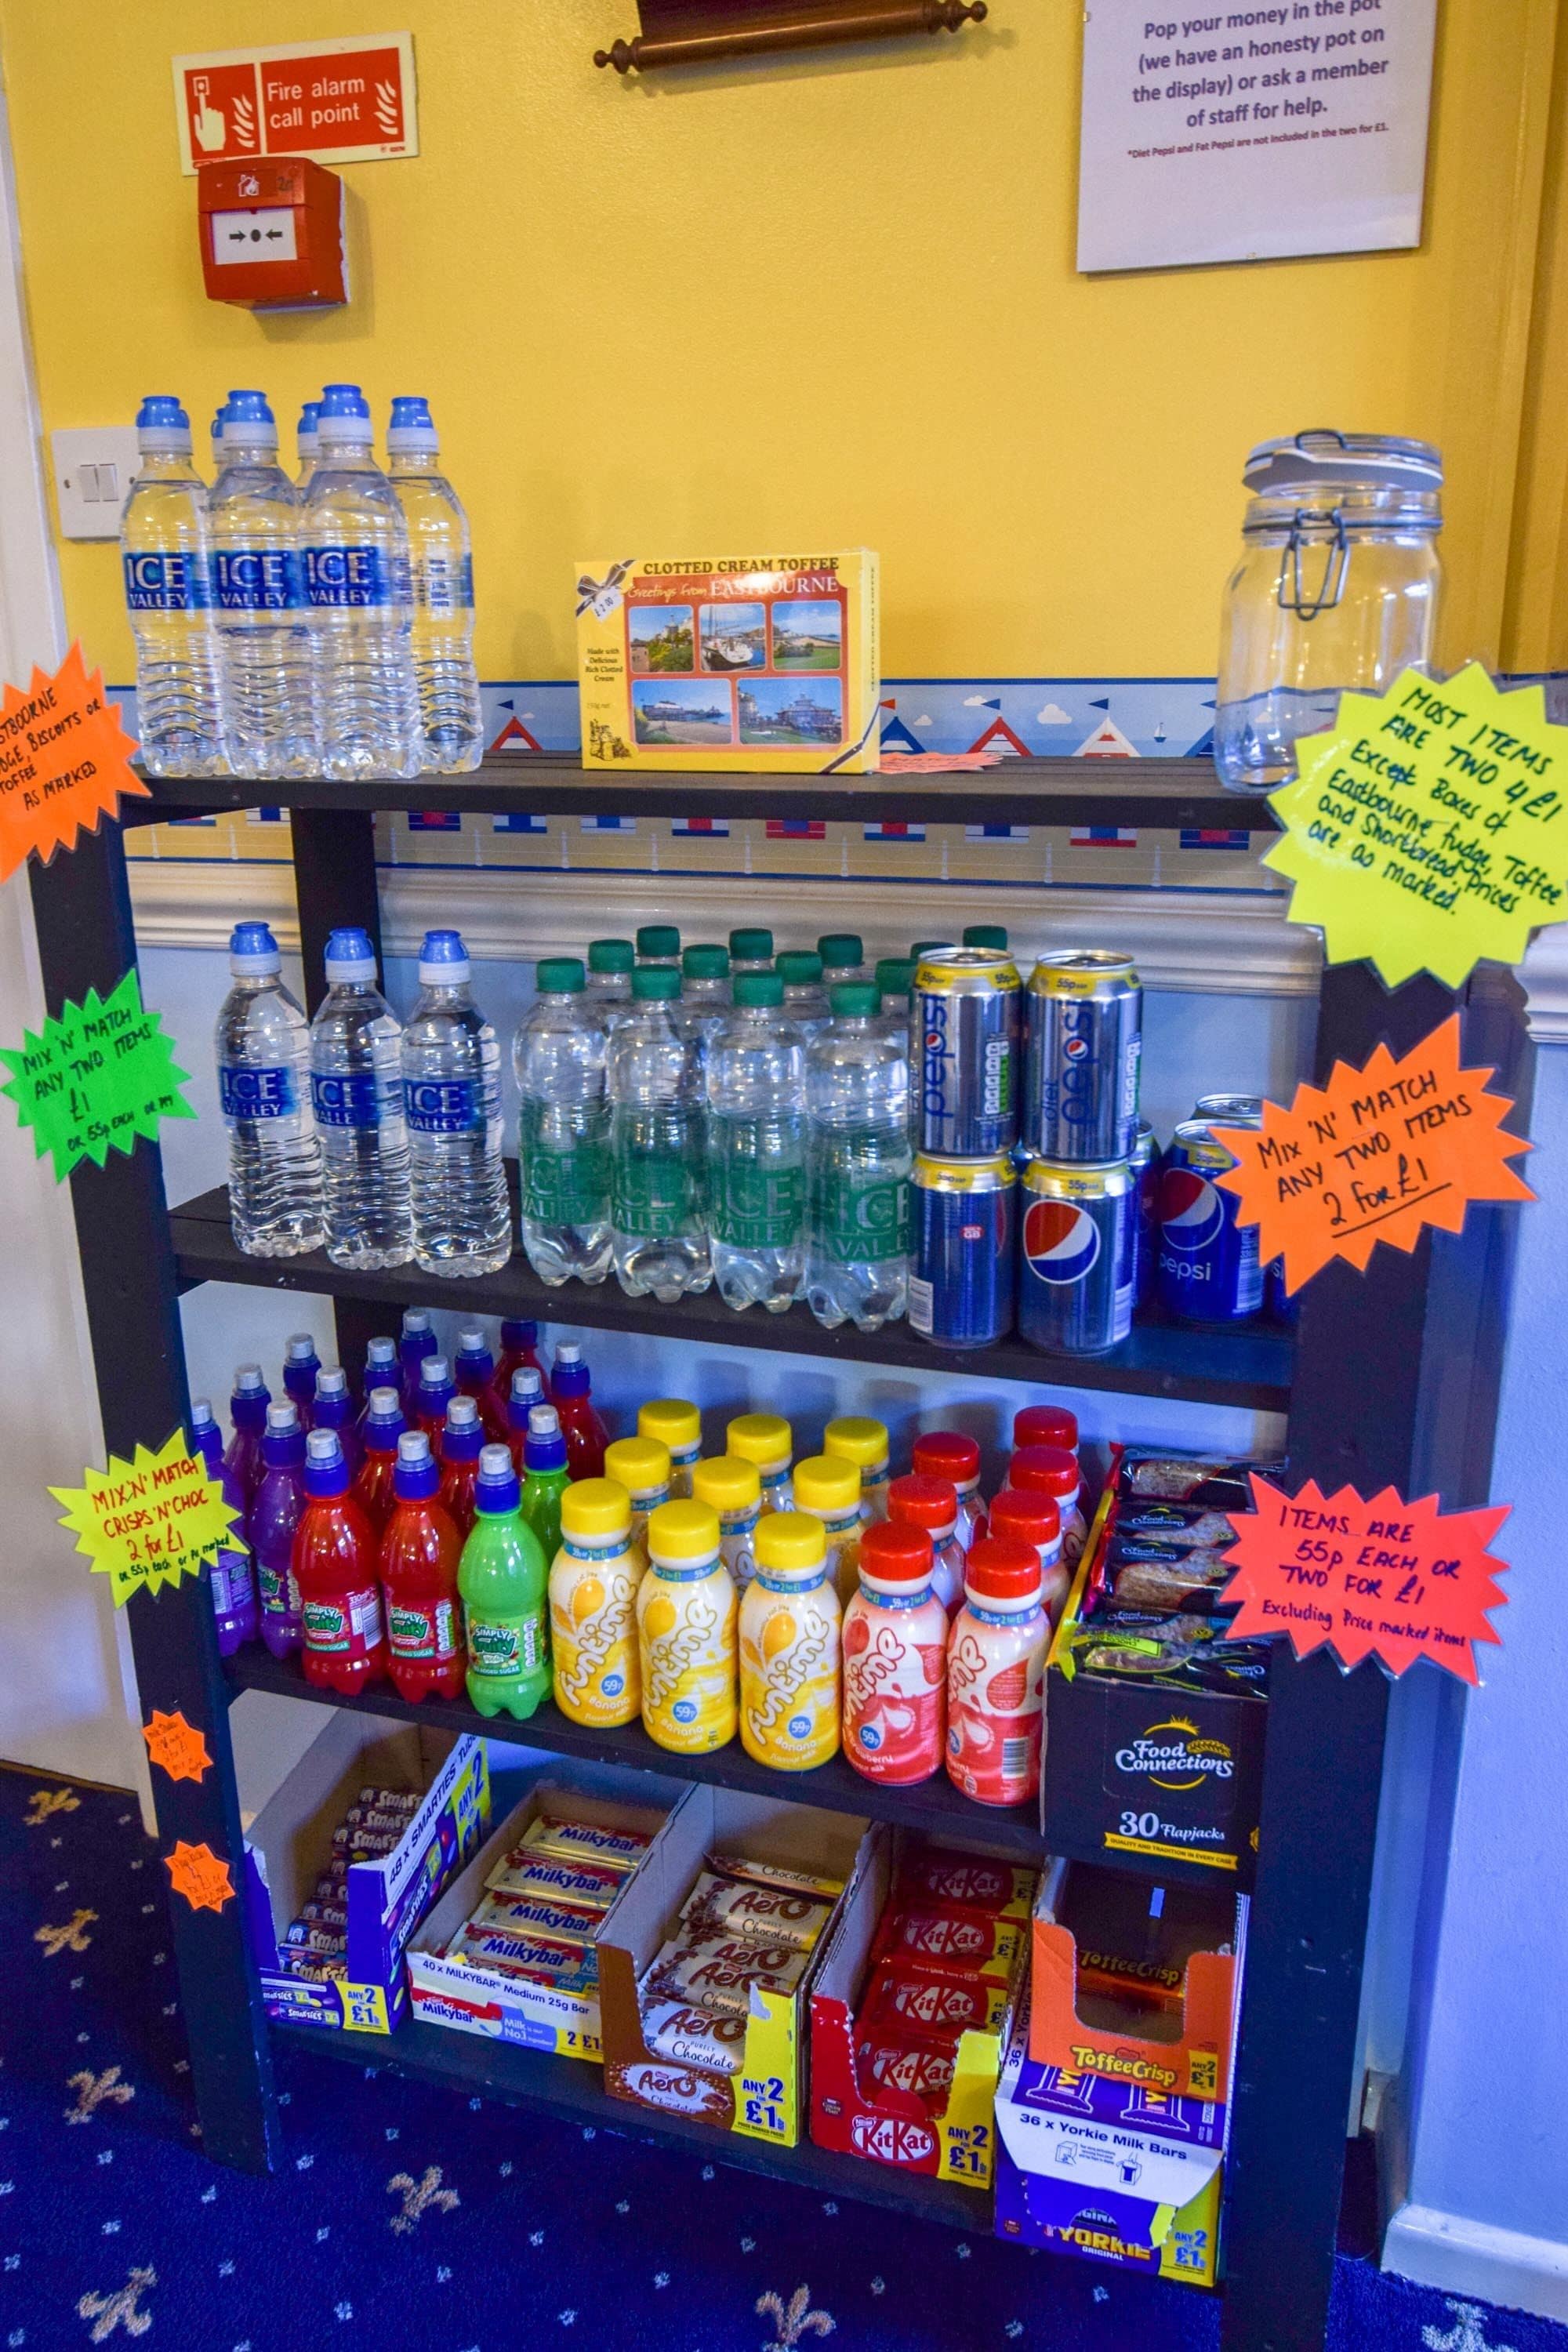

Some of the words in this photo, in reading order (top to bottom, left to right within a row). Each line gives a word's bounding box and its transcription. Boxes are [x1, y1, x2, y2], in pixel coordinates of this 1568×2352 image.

[1145, 23, 1177, 39] Pop
[1182, 16, 1221, 38] your
[1227, 9, 1288, 27] money
[1293, 3, 1308, 20] in
[1315, 0, 1345, 16] the
[1350, 0, 1381, 16] pot
[1139, 53, 1171, 74] (we
[1176, 49, 1217, 66] have
[1222, 45, 1243, 60] an
[1249, 36, 1320, 57] honesty
[1326, 30, 1356, 52] pot
[1361, 28, 1384, 43] on
[267, 82, 303, 101] Fire
[311, 78, 365, 97] alarm
[1132, 85, 1160, 103] the
[1166, 74, 1232, 100] display)
[1238, 76, 1257, 89] or
[1261, 68, 1290, 87] ask
[1296, 70, 1305, 83] a
[1312, 59, 1389, 81] member
[270, 109, 303, 129] call
[311, 103, 361, 129] point
[1186, 109, 1205, 127] of
[1209, 103, 1249, 125] staff
[1253, 103, 1279, 119] for
[1284, 96, 1327, 117] help.
[1152, 146, 1175, 157] Pepsi
[1177, 143, 1193, 154] and
[1196, 143, 1209, 151] Fat
[1211, 140, 1234, 150] Pepsi
[1236, 138, 1250, 147] are
[1253, 136, 1269, 145] not
[1271, 131, 1308, 143] included
[1311, 130, 1319, 139] in
[1322, 129, 1337, 137] the
[1339, 127, 1357, 136] two
[1359, 124, 1373, 133] for
[128, 558, 186, 590] ICE
[307, 552, 369, 585] ICE
[644, 562, 712, 575] CLOTTED
[717, 560, 772, 572] CREAM
[779, 557, 839, 570] TOFFEE
[129, 593, 189, 608] VALLEY
[309, 590, 372, 604] VALLEY
[628, 584, 677, 601] Greetings
[681, 583, 706, 596] from
[1400, 688, 1468, 729] MOST
[1469, 724, 1554, 776] ITEMS
[1381, 714, 1432, 750] ARE
[1445, 745, 1499, 785] TWO
[23, 789, 40, 811] AS
[43, 760, 96, 799] MARKED
[1350, 739, 1418, 790] Except
[1429, 779, 1484, 821] Boxes
[1484, 811, 1512, 837] of
[1319, 795, 1356, 826] and
[1308, 820, 1341, 850] are
[1352, 845, 1375, 868] as
[1328, 769, 1434, 839] Eastbourne
[1504, 855, 1563, 906] Toffee
[23, 1048, 53, 1076] MIX
[83, 1008, 132, 1043] MATCH
[919, 993, 956, 1118] pepsi
[34, 1072, 64, 1101] ANY
[69, 1051, 105, 1081] TWO
[113, 1023, 151, 1059] ITEMS
[1057, 1000, 1099, 1125] pepsi
[405, 1085, 461, 1114] ICE
[1352, 1070, 1438, 1125] MATCH
[408, 1116, 463, 1131] VALLEY
[1278, 1162, 1323, 1203] ANY
[1334, 1131, 1391, 1170] TWO
[1405, 1094, 1472, 1140] ITEMS
[1323, 1192, 1347, 1225] 2
[1399, 1153, 1428, 1196] £1
[1160, 1253, 1211, 1281] pepsi
[91, 1484, 127, 1514] MIX
[151, 1458, 198, 1490] MATCH
[103, 1509, 154, 1539] CRISPS
[172, 1488, 209, 1514] CHOC
[1279, 1505, 1350, 1535] ITEMS
[1367, 1520, 1415, 1543] ARE
[126, 1539, 143, 1561] 2
[144, 1534, 162, 1560] for
[1294, 1540, 1343, 1571] 55p
[1357, 1546, 1418, 1571] EACH
[1431, 1559, 1461, 1580] OR
[1279, 1564, 1329, 1588] TWO
[1344, 1573, 1382, 1599] FOR
[1394, 1574, 1425, 1606] £1
[1262, 1599, 1333, 1632] Excluding
[1342, 1609, 1374, 1631] Price
[1378, 1620, 1429, 1640] marked
[603, 1679, 622, 1692] 59p
[1115, 1748, 1235, 1778] Connections
[1133, 1740, 1186, 1760] Food
[411, 1766, 458, 1849] SMARTIES
[559, 1828, 640, 1852] Milkybar
[1119, 1811, 1160, 1838] 30
[1160, 1824, 1225, 1842] Flapjacks
[742, 1918, 801, 1944] Chocolate
[483, 1937, 575, 1967] Milkybar
[423, 1960, 435, 1970] 40
[503, 1984, 546, 2003] Medium
[549, 1997, 568, 2012] 25g
[572, 2003, 590, 2014] Bar
[422, 2002, 477, 2024] Milkybar
[672, 2040, 735, 2070] Chocolate
[742, 2079, 765, 2094] ANY
[768, 2078, 783, 2102] 2
[746, 2100, 775, 2127] £1
[862, 2119, 928, 2160] KitKat
[948, 2126, 970, 2140] ANY
[972, 2125, 989, 2148] 2
[1020, 2113, 1040, 2127] 36
[1045, 2122, 1054, 2130] x
[1059, 2122, 1109, 2143] Yorkie
[1112, 2136, 1144, 2150] Milk
[1149, 2143, 1188, 2160] Bars
[949, 2146, 978, 2172] £1
[1058, 2227, 1151, 2260] YORKIE
[1082, 2245, 1124, 2262] ORIGINAL
